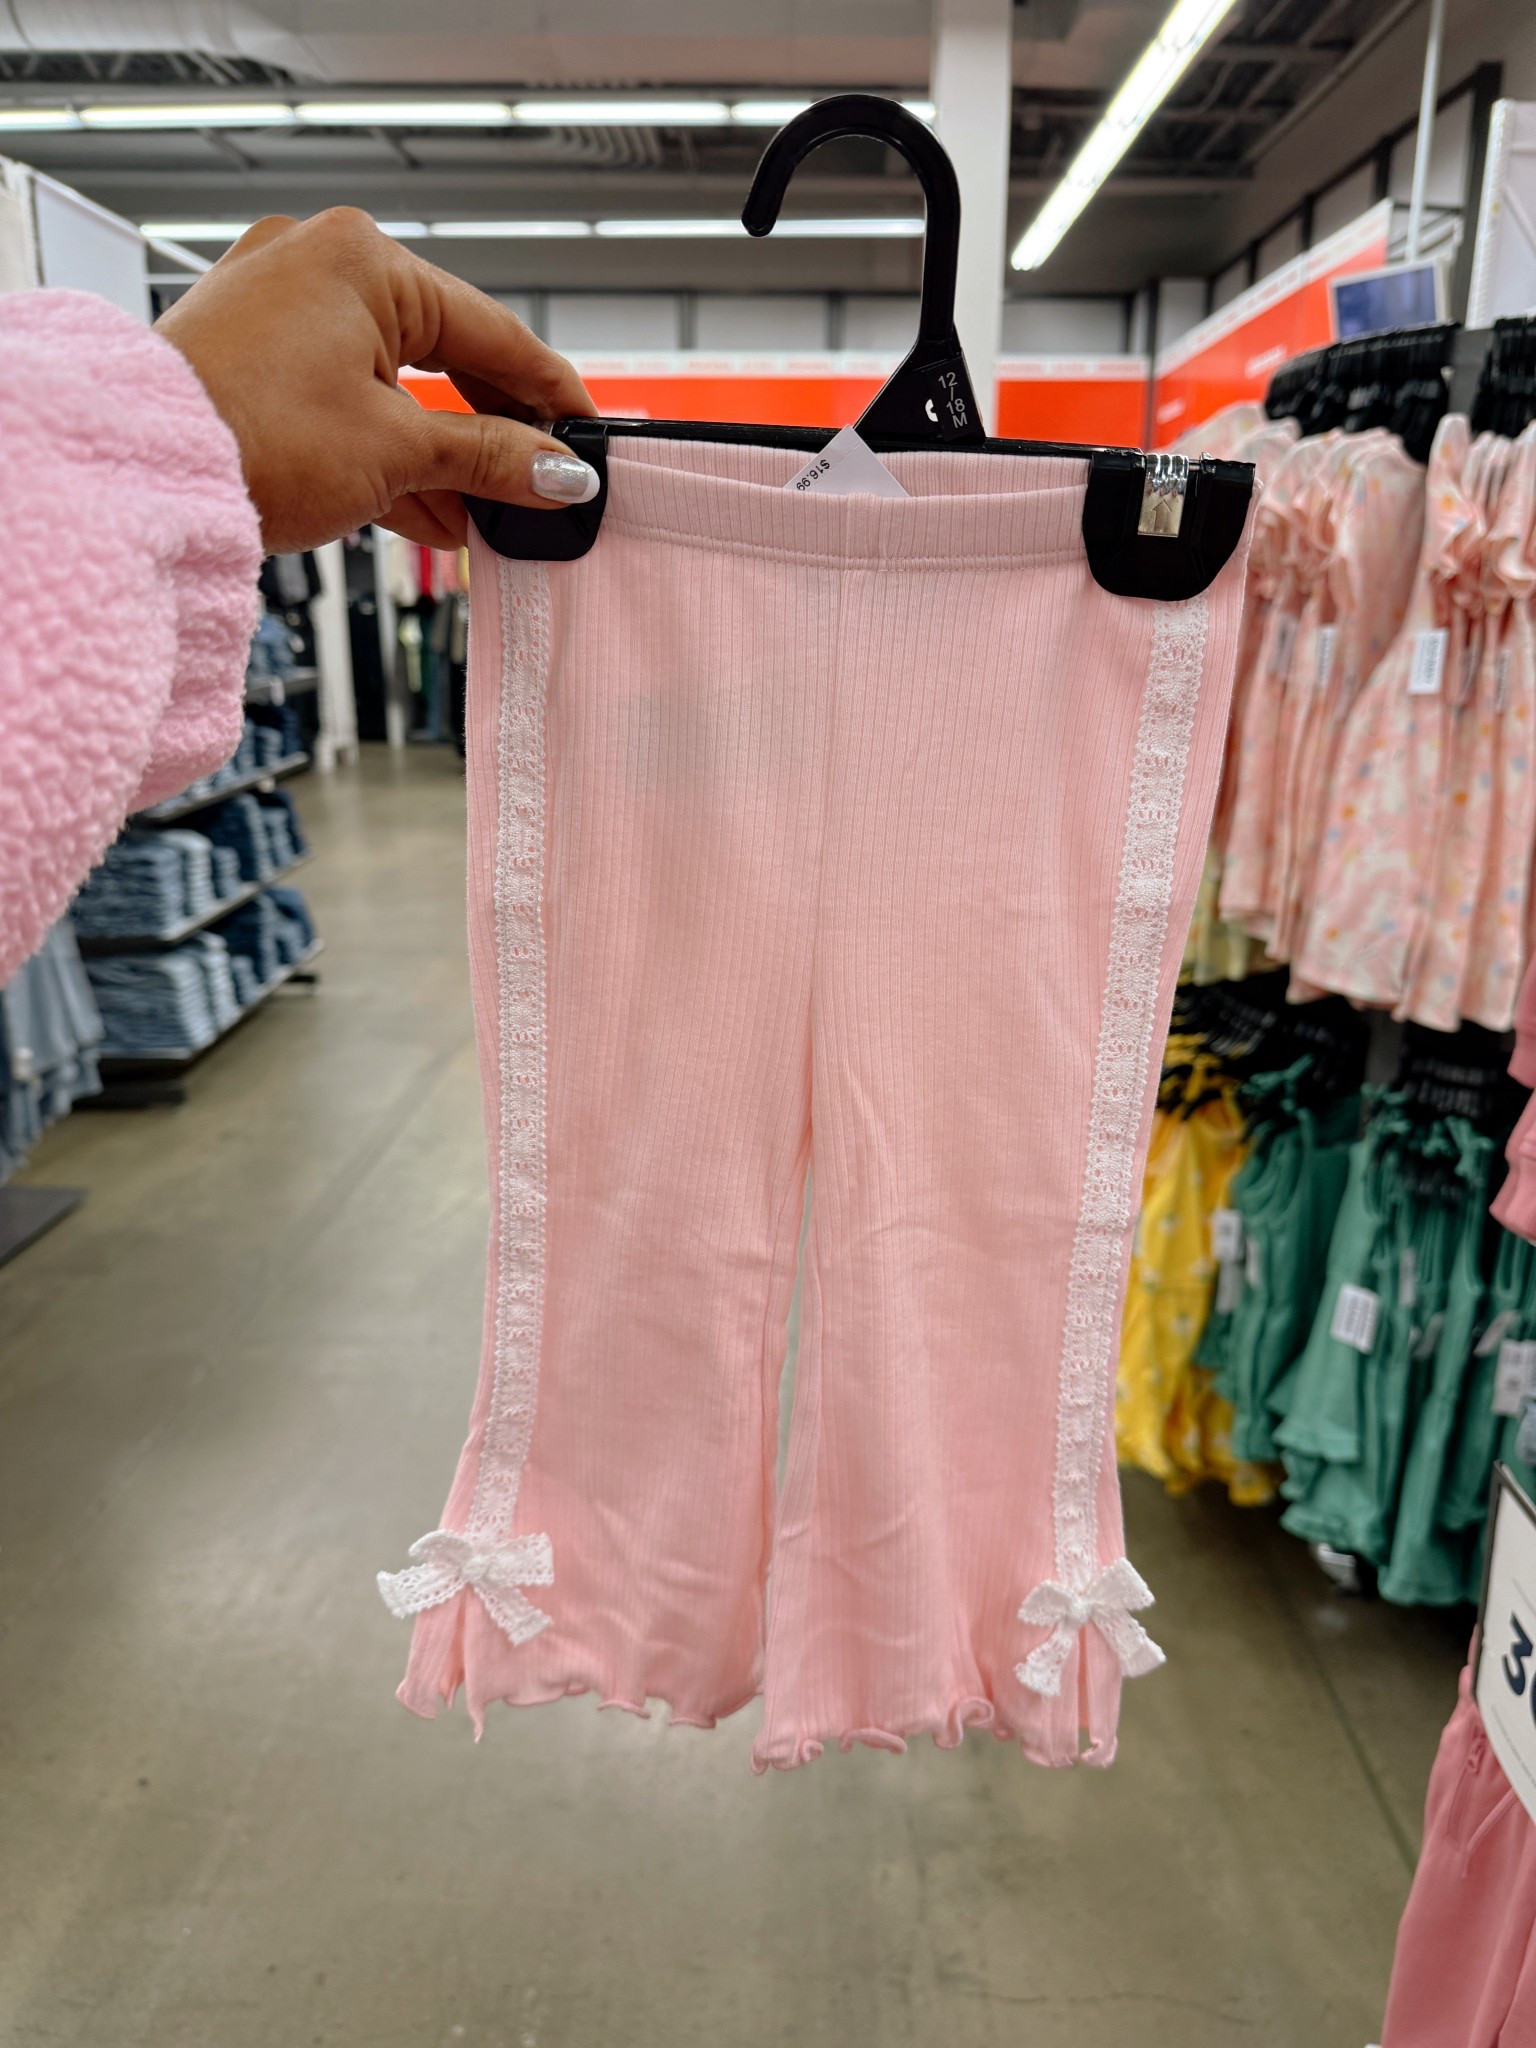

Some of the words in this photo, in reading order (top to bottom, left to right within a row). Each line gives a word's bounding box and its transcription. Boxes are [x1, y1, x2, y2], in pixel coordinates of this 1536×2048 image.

[938, 371, 958, 389] 12
[946, 398, 965, 415] 18
[952, 411, 968, 429] M
[796, 459, 830, 491] $16.99
[1501, 1610, 1536, 1730] 3
